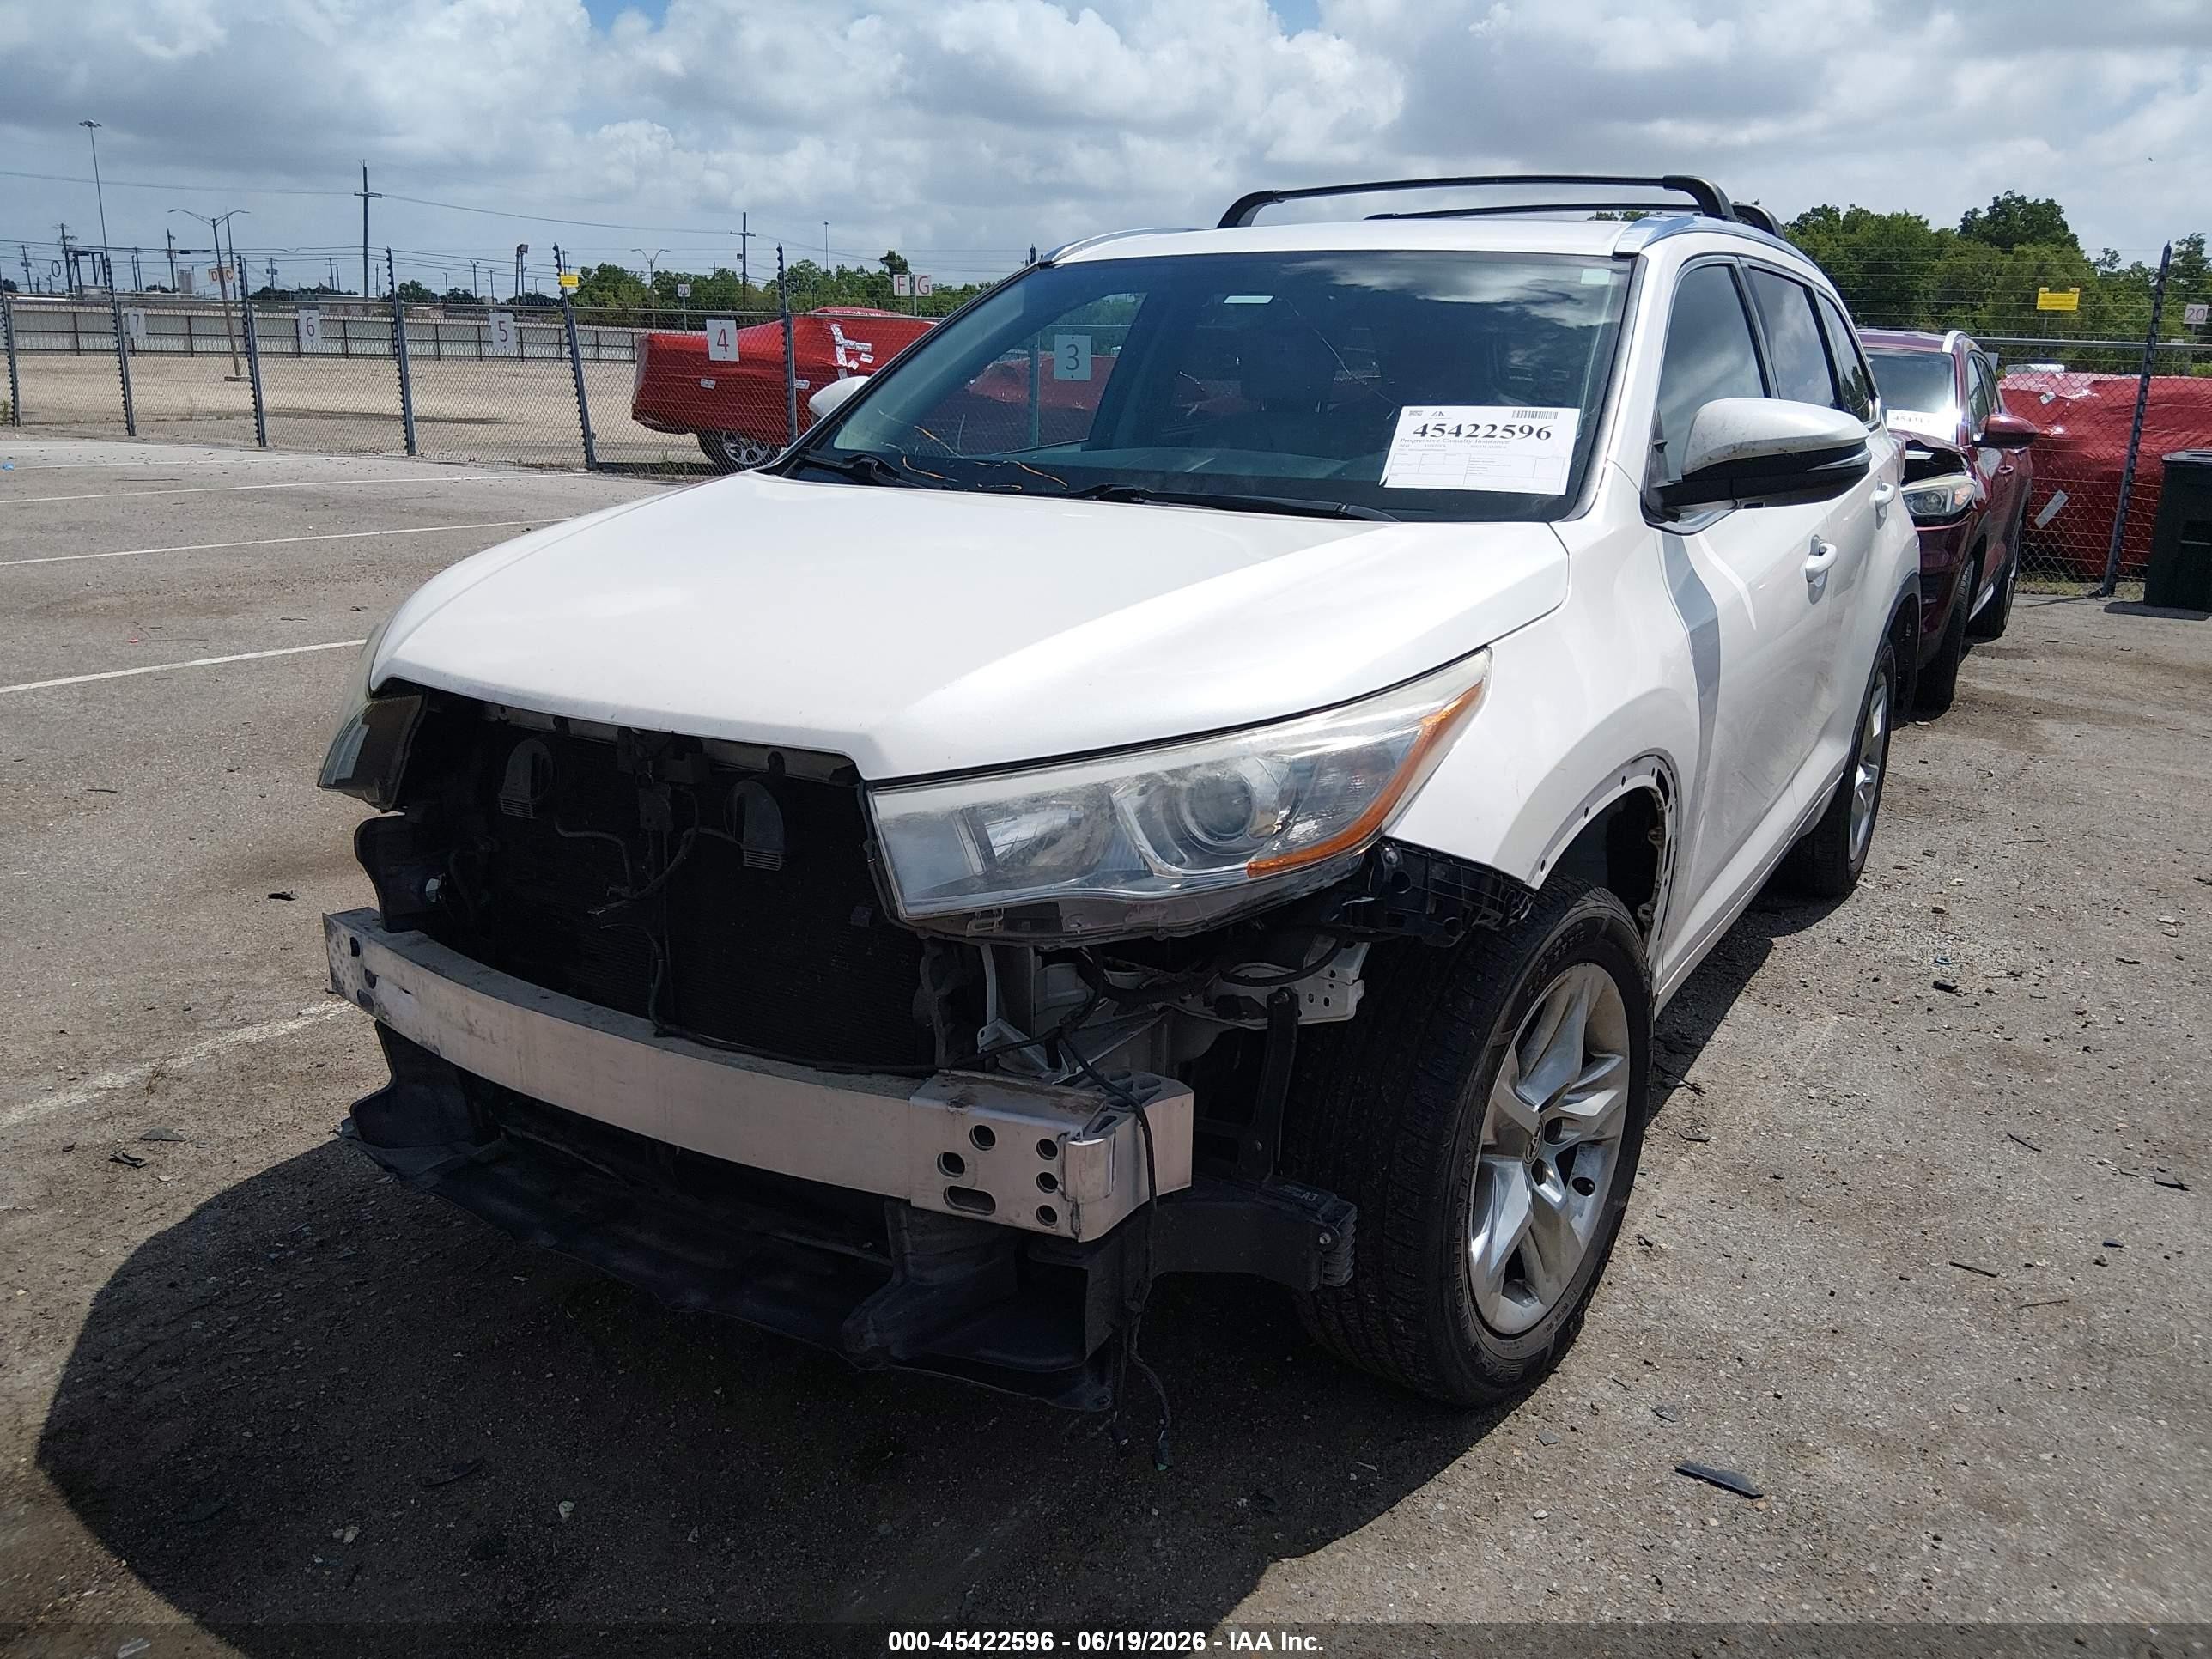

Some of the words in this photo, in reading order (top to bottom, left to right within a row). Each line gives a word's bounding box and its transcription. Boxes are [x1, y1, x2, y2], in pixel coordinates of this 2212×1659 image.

[225, 270, 234, 281] C
[897, 276, 906, 295] F
[917, 276, 930, 295] G
[133, 314, 140, 332] 7
[2185, 307, 2206, 321] 20
[307, 317, 315, 337] 6
[497, 320, 508, 343] 5
[716, 328, 730, 353] 4
[1065, 343, 1080, 371] 3
[1413, 422, 1553, 441] 45422596
